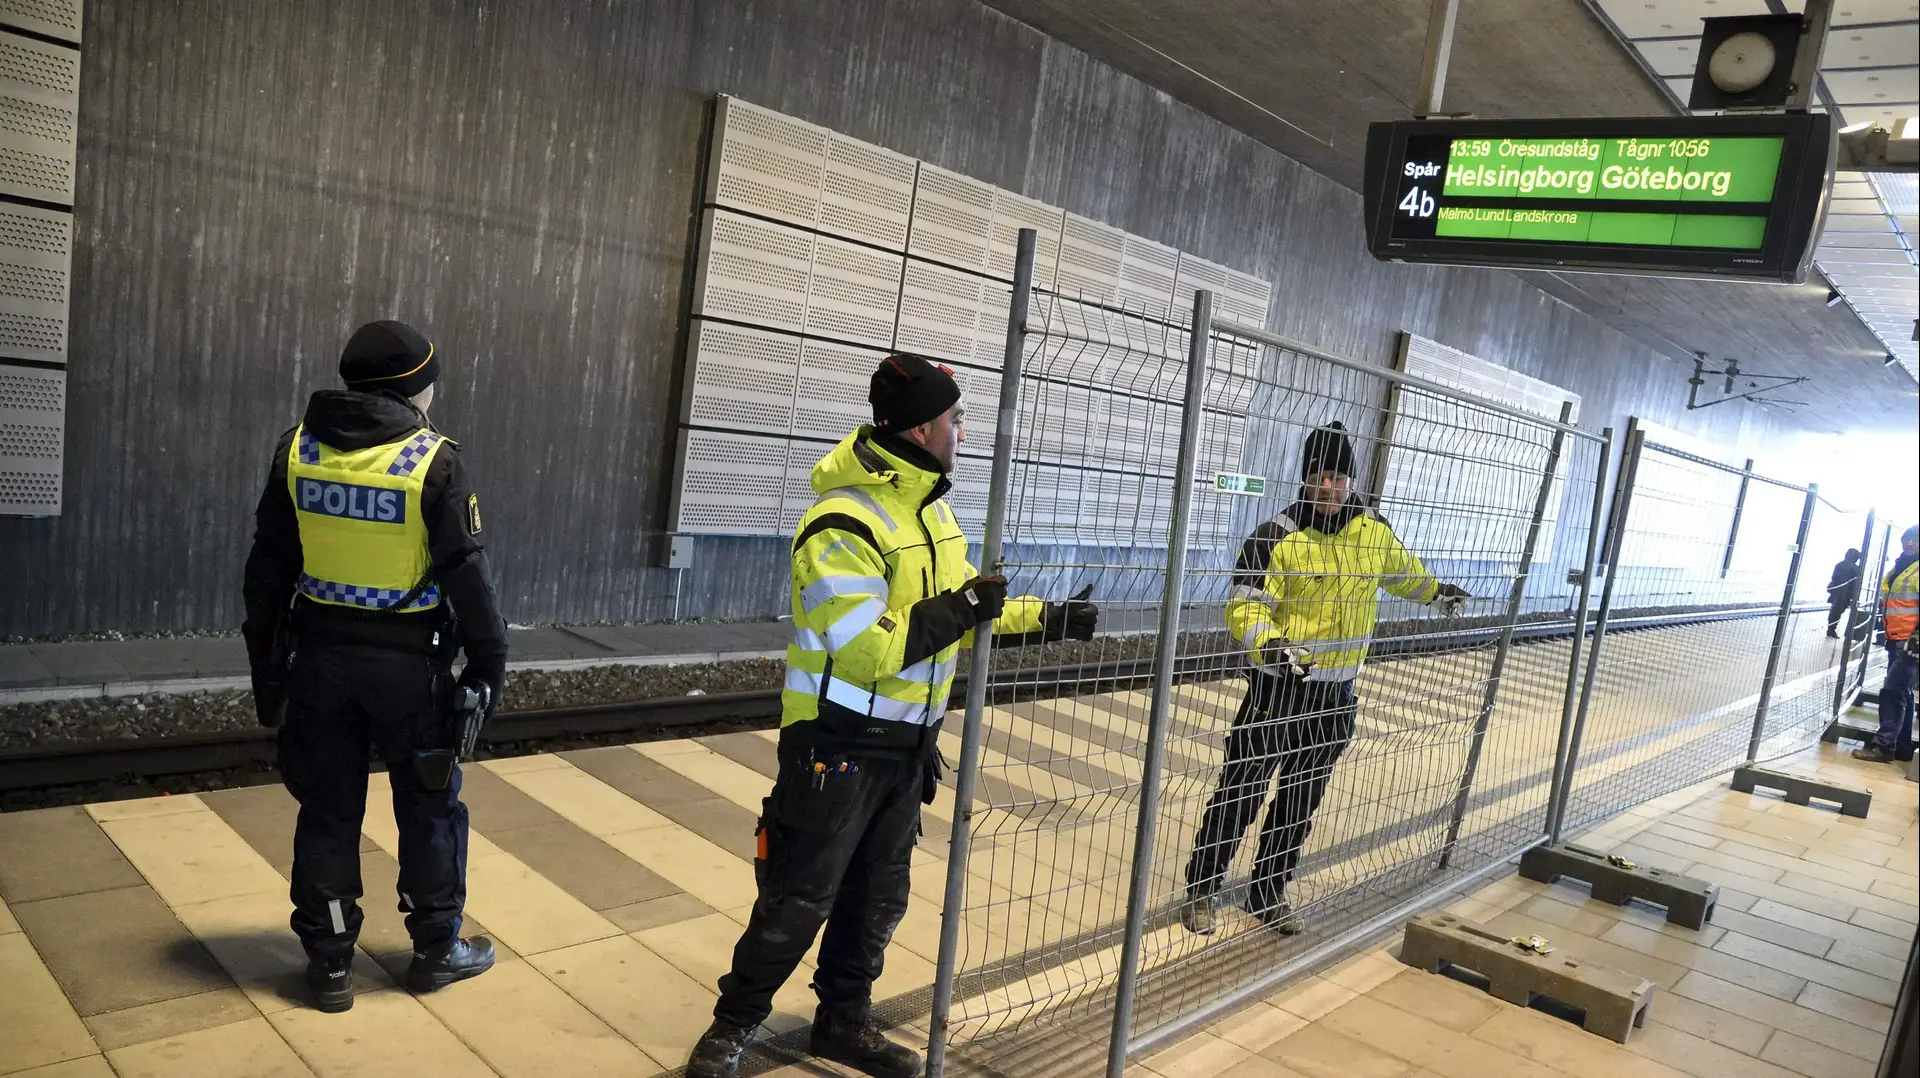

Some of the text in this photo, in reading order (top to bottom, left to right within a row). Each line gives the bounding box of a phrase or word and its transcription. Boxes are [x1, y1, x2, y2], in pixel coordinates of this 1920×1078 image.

[1450, 138, 1710, 161] 13:59 Öresundståg Tågnr 1056
[1404, 161, 1441, 179] Spår
[1445, 164, 1731, 197] Helsingborg Göteborg
[1398, 186, 1435, 218] 4b
[1438, 207, 1578, 224] Malmö Lund Landskrona
[302, 480, 397, 521] POLIS
